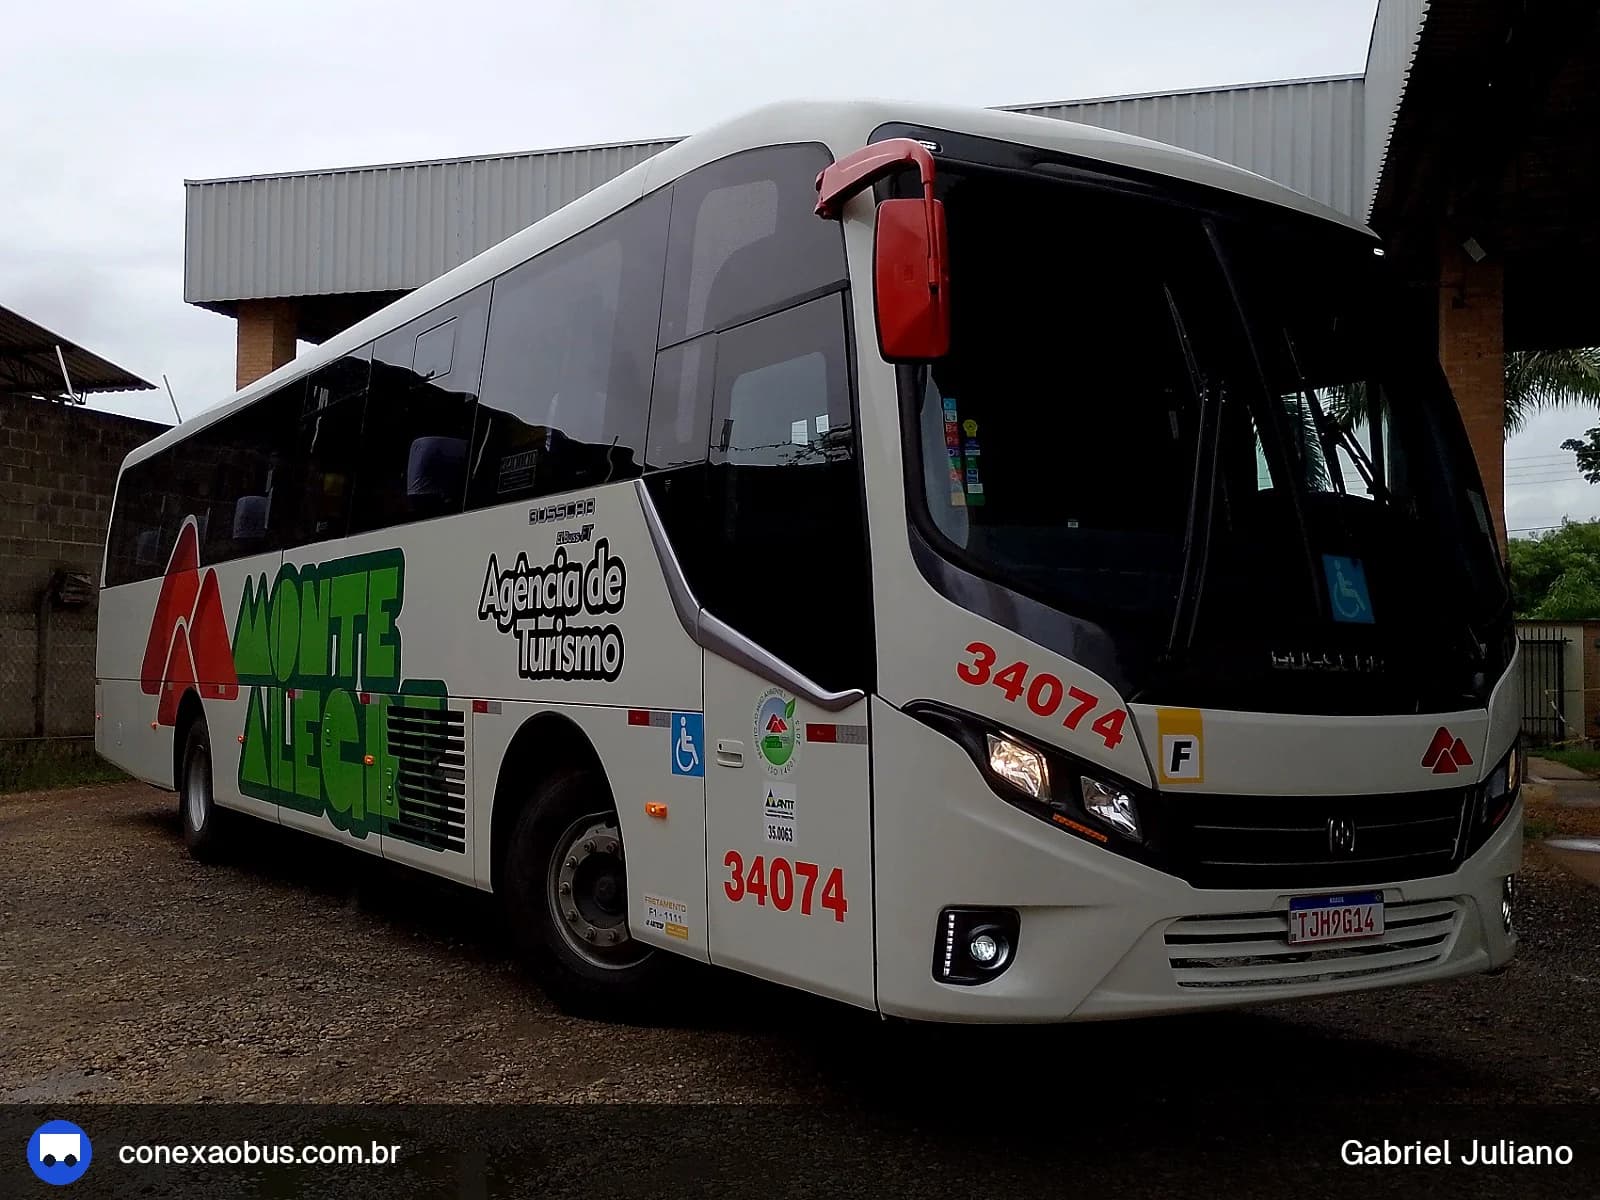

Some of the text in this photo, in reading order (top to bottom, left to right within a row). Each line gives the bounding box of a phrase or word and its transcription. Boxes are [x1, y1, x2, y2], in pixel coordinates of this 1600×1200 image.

[233, 556, 401, 687] MONTE
[480, 543, 625, 629] Agência de
[515, 615, 622, 676] Turismo
[956, 641, 1128, 749] 34074
[1170, 740, 1193, 772] F
[723, 850, 848, 923] 34074
[1298, 907, 1375, 938] TJH9G14
